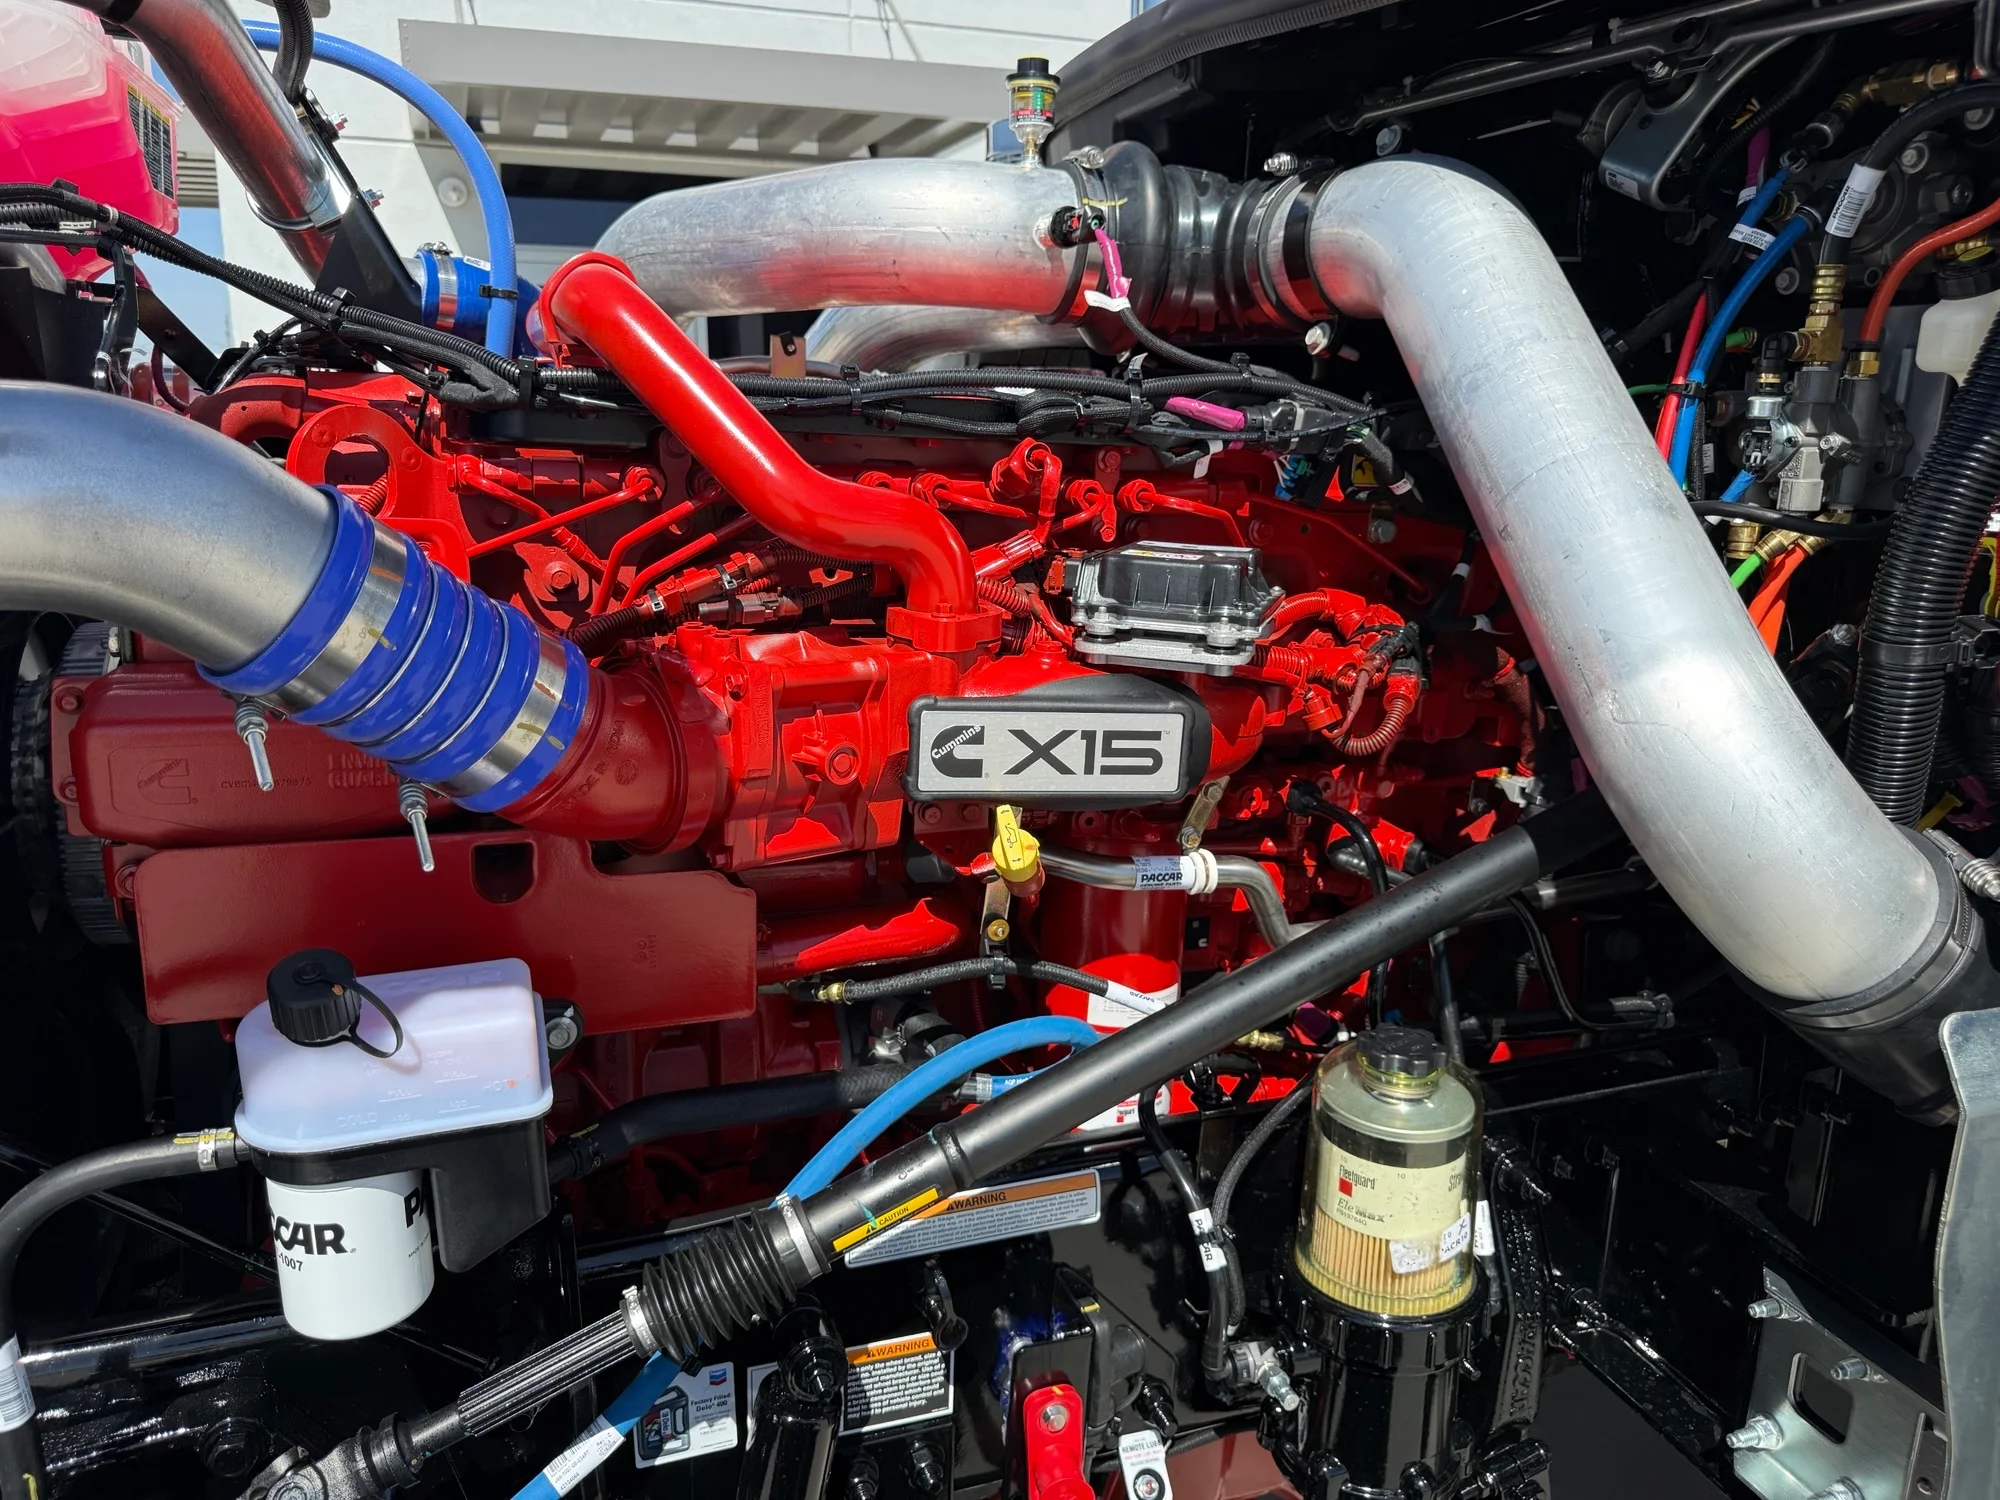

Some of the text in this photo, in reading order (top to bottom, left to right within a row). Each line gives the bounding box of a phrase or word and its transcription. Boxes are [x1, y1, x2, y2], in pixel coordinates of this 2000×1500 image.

[604, 720, 625, 758] INDIA
[931, 725, 982, 759] Cummins
[1003, 729, 1163, 775] X15
[1142, 872, 1183, 882] PACCAR
[336, 1112, 378, 1128] COLD
[1339, 1165, 1375, 1190] Fleetguard
[953, 1192, 1006, 1208] WARNING
[879, 1206, 909, 1226] CAUTION
[876, 1340, 930, 1357] WARNING
[691, 1396, 712, 1406] Factory
[1122, 1442, 1145, 1453] REMOTE
